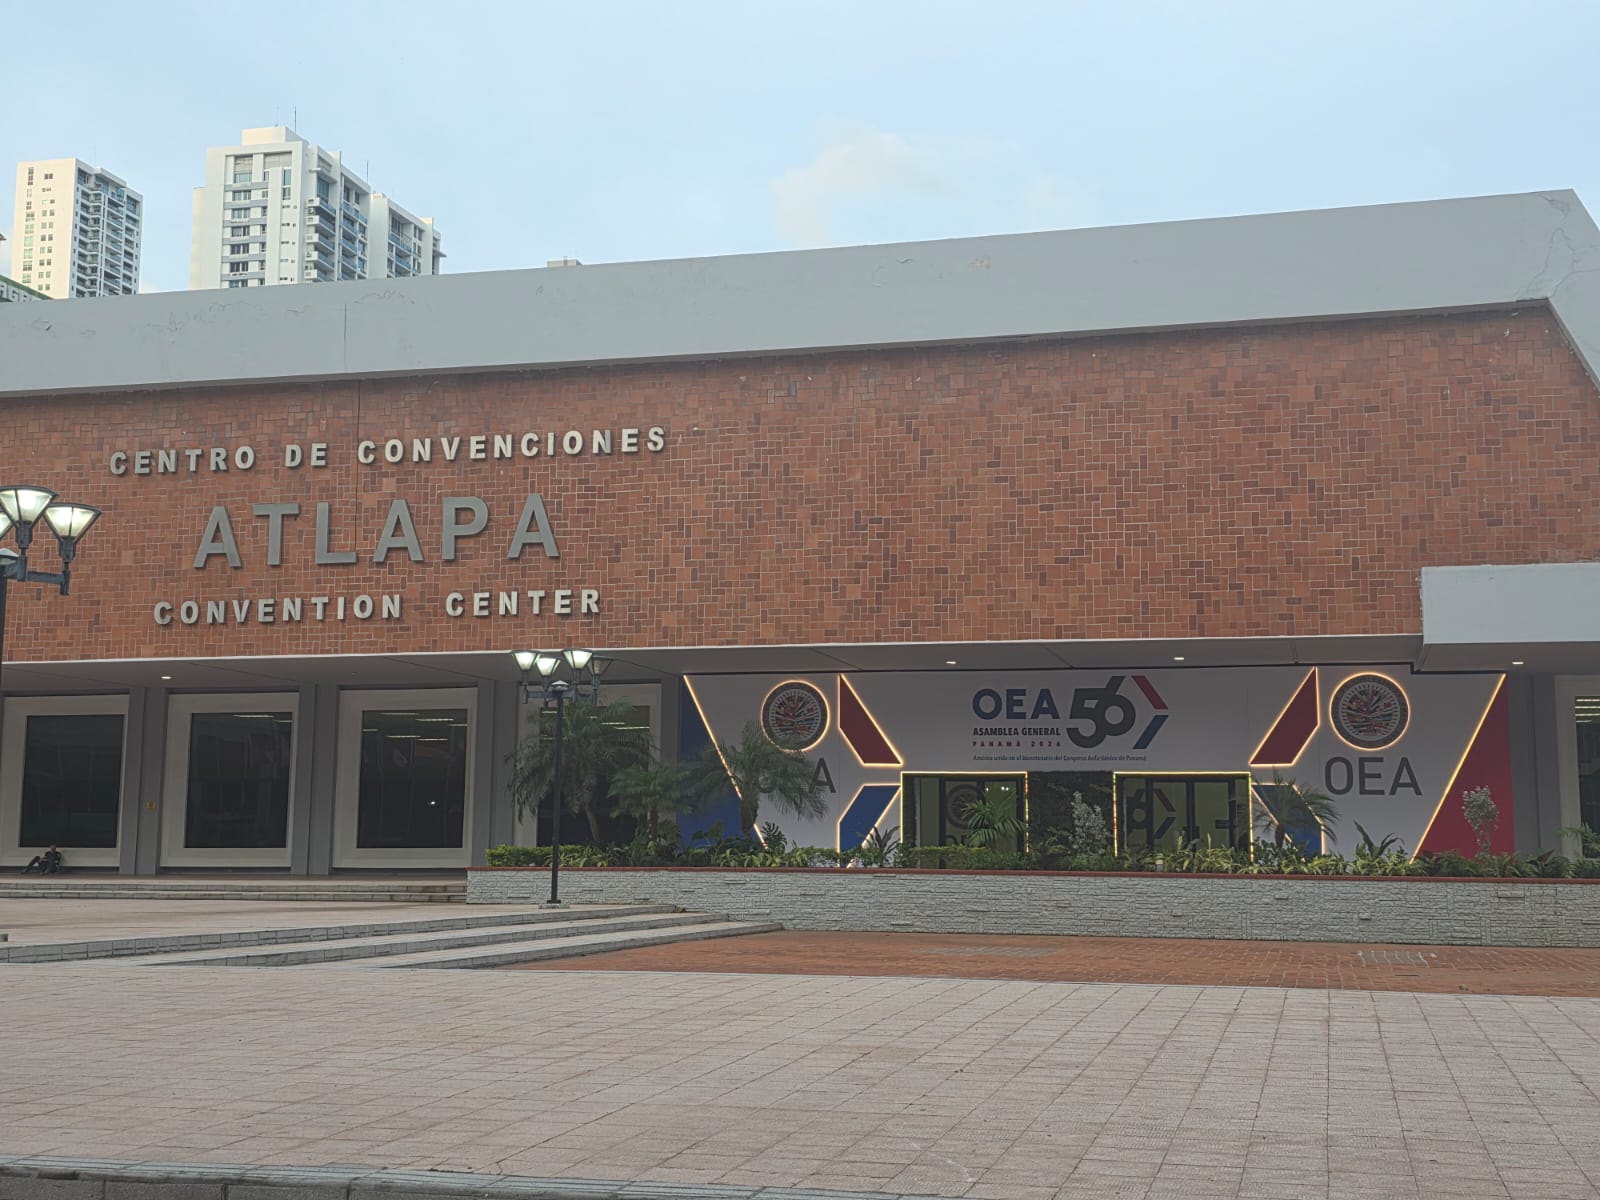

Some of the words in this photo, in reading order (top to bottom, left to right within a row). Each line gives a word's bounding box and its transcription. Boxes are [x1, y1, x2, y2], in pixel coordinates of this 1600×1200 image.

[110, 445, 256, 475] CENTRO
[285, 442, 328, 468] DE
[357, 426, 666, 464] CONVENCIONES
[193, 493, 561, 568] ATLAPA
[153, 593, 402, 625] CONVENTION
[445, 588, 601, 617] CENTER
[972, 688, 1060, 720] OEA
[1066, 676, 1136, 748] 56
[972, 727, 1019, 736] ASAMBLEA
[1021, 727, 1061, 736] GENERAL
[1324, 756, 1422, 796] OEA
